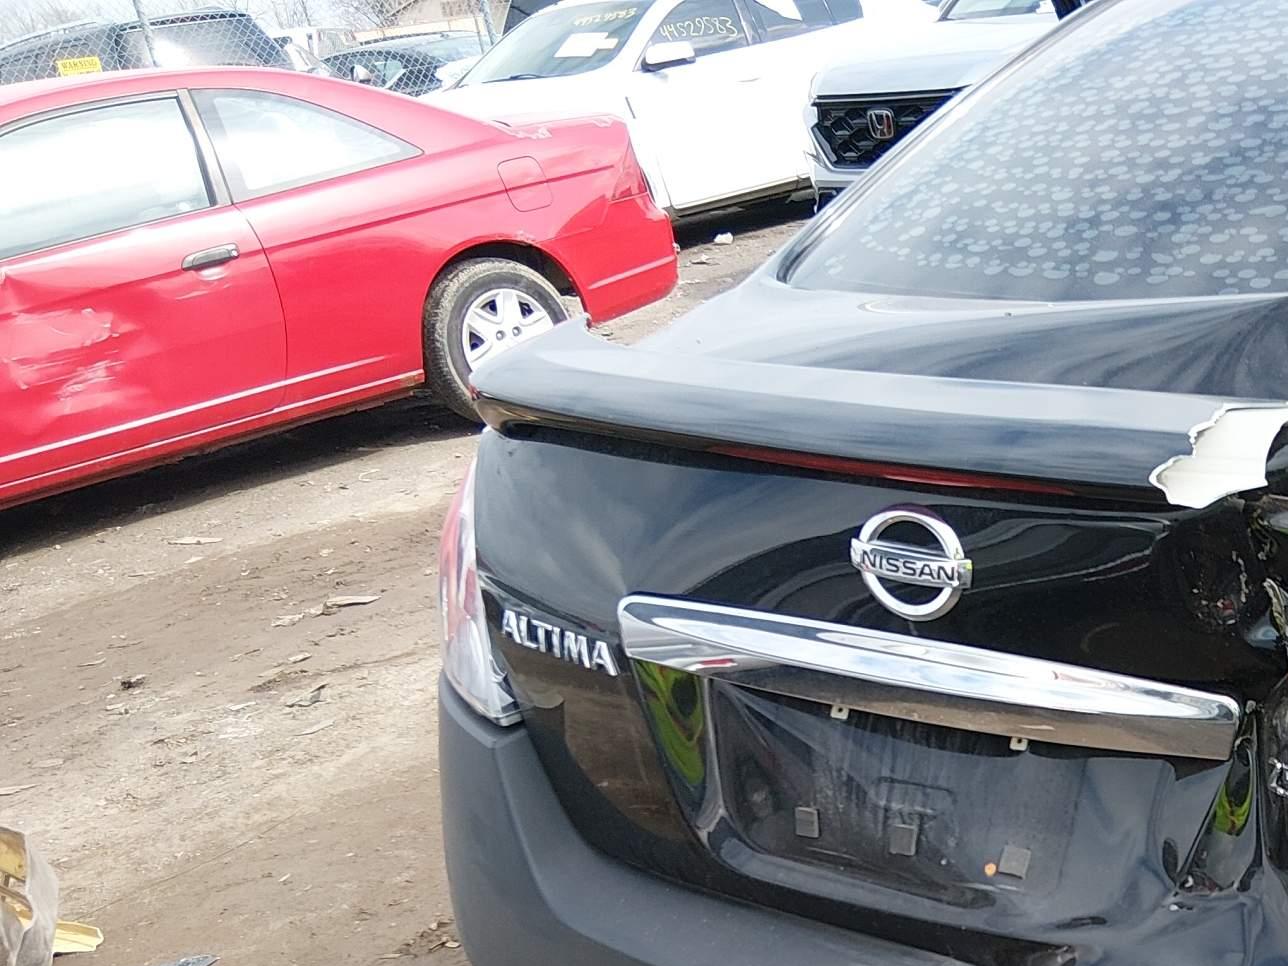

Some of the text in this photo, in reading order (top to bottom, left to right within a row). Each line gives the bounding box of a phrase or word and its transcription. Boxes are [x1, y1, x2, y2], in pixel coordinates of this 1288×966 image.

[659, 16, 738, 41] 44529583
[862, 549, 955, 582] NISSAN
[501, 608, 618, 677] ALTIMA
